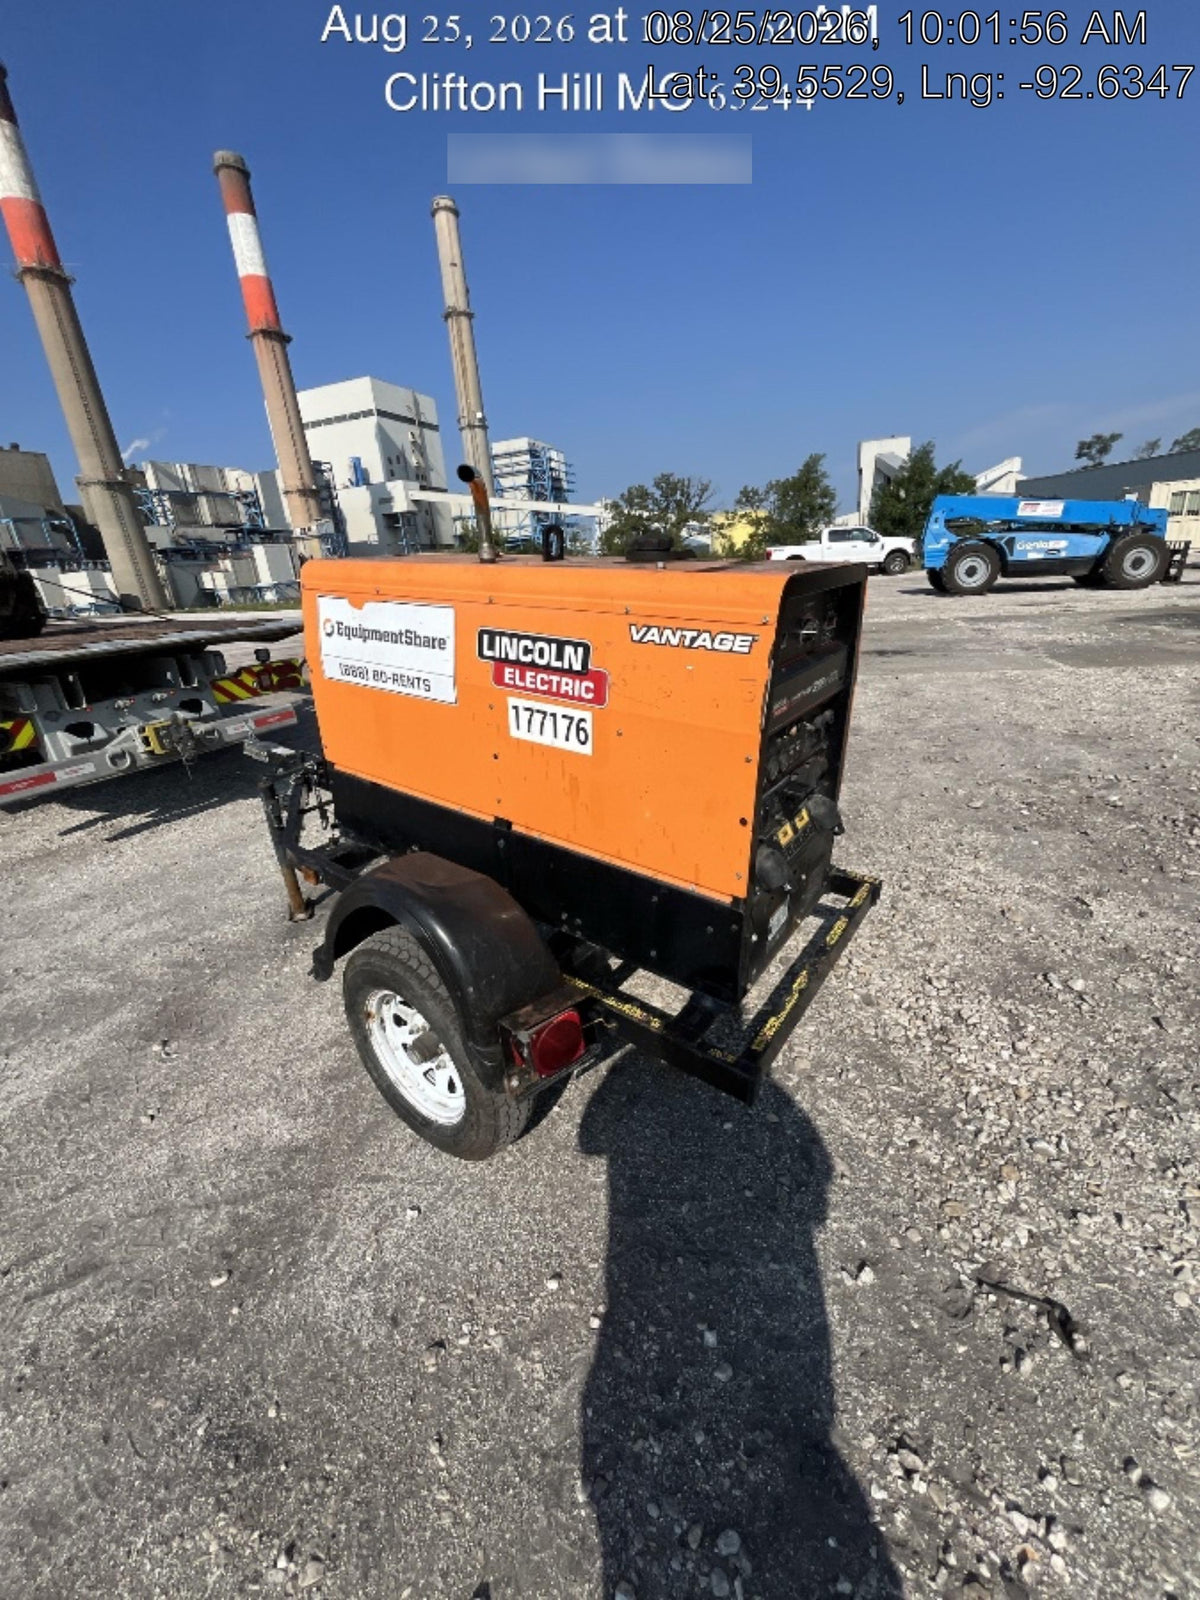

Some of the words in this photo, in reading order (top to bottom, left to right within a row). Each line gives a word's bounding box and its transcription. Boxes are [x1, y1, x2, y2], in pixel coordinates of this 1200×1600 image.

[336, 620, 448, 650] EquipmentShare
[628, 624, 755, 655] VANTAGE
[481, 633, 584, 672] LINCOLN
[503, 666, 595, 700] ELECTRIC
[511, 704, 590, 747] 177176
